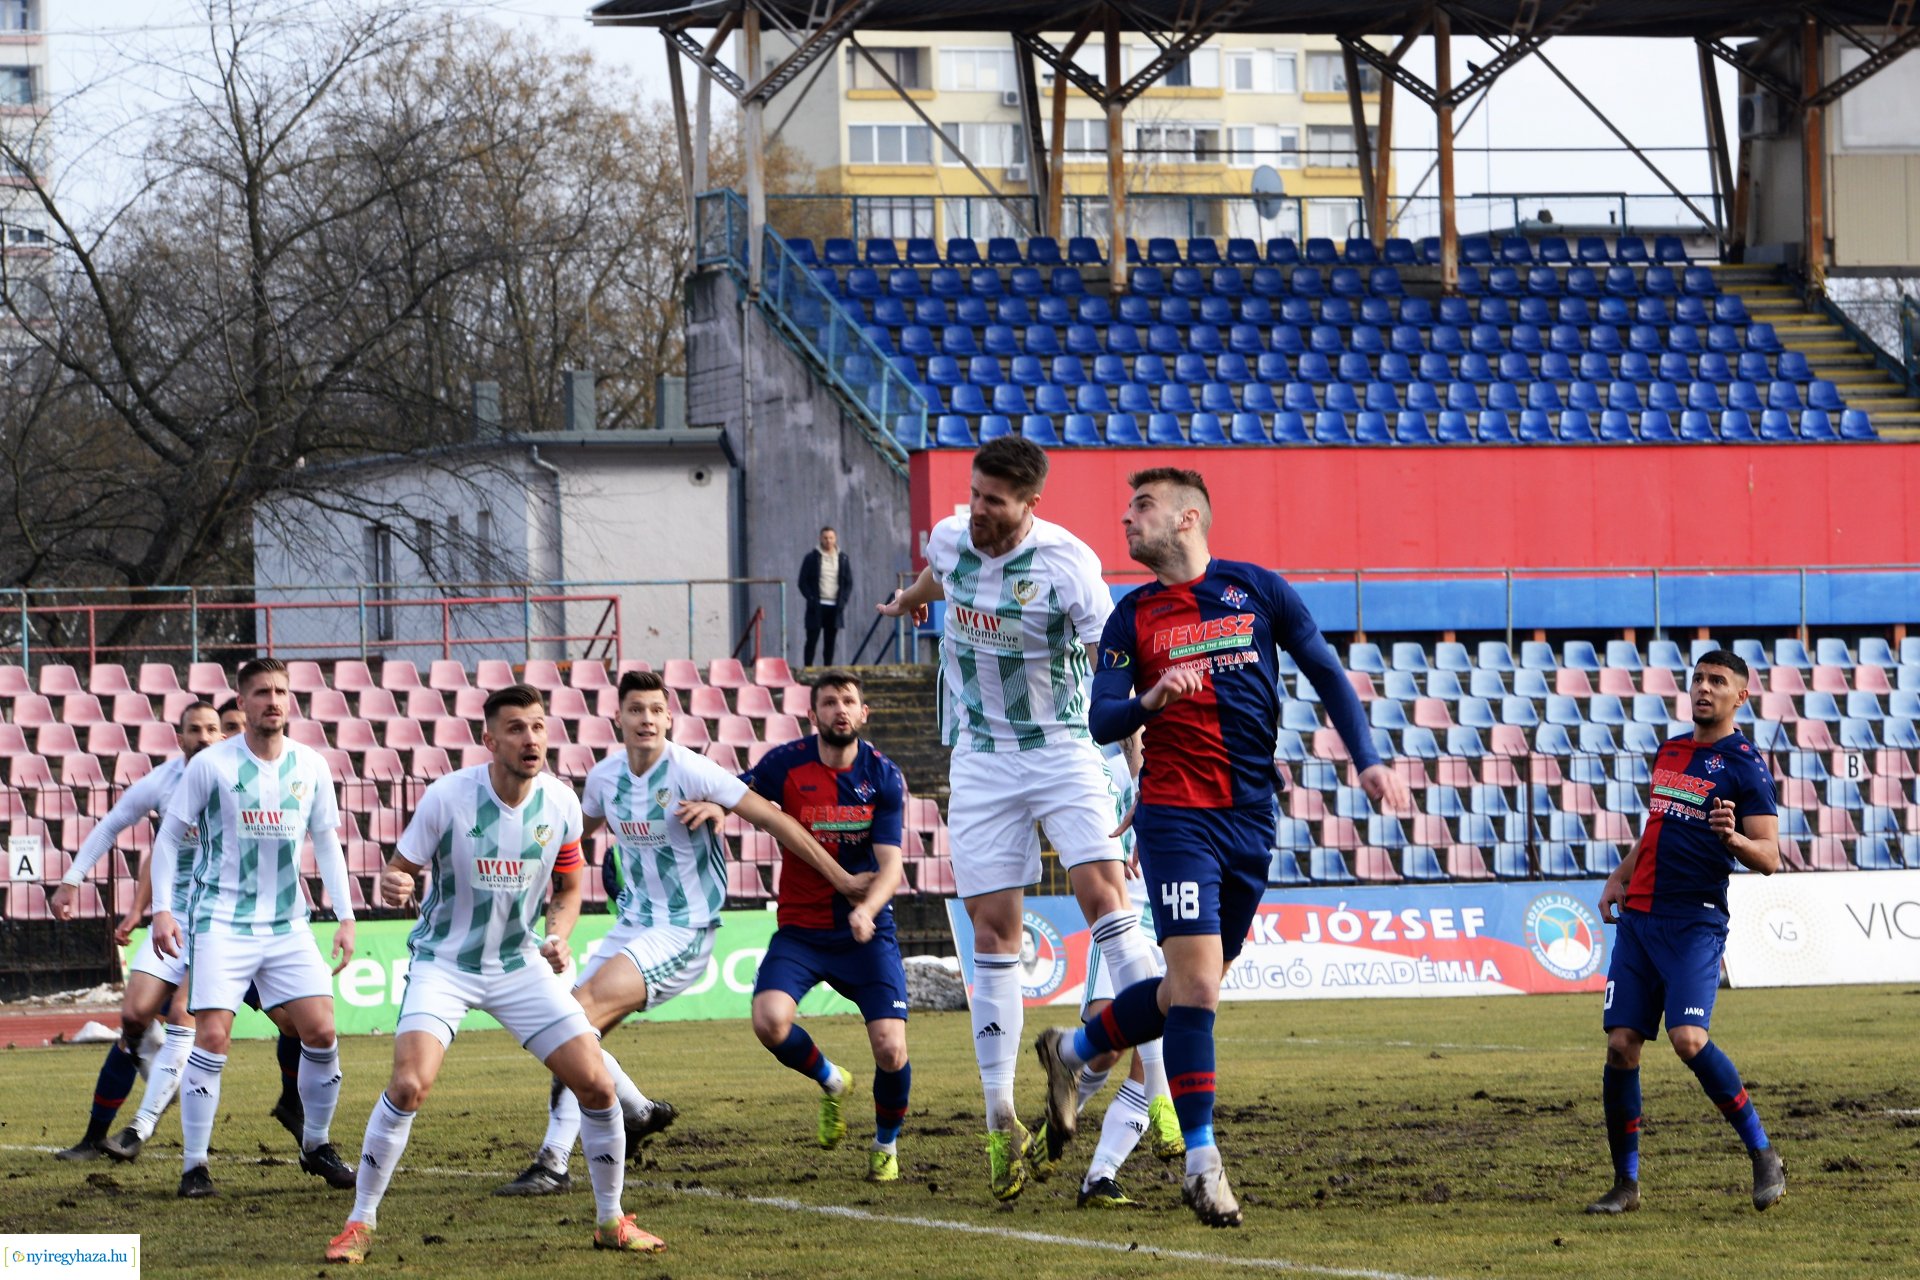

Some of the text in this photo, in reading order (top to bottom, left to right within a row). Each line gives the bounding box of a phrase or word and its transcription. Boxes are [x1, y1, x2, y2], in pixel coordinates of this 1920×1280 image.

[960, 624, 1019, 643] automotive
[1153, 613, 1255, 654] REVESZ
[1171, 646, 1196, 658] ALWAYS
[1848, 754, 1859, 778] B
[246, 825, 296, 833] automotive
[17, 855, 34, 876] A
[1162, 881, 1200, 920] 48
[1301, 901, 1486, 943] JÓZSEF
[1322, 954, 1503, 987] AKADÉMIA
[1684, 1006, 1705, 1017] JAKO
